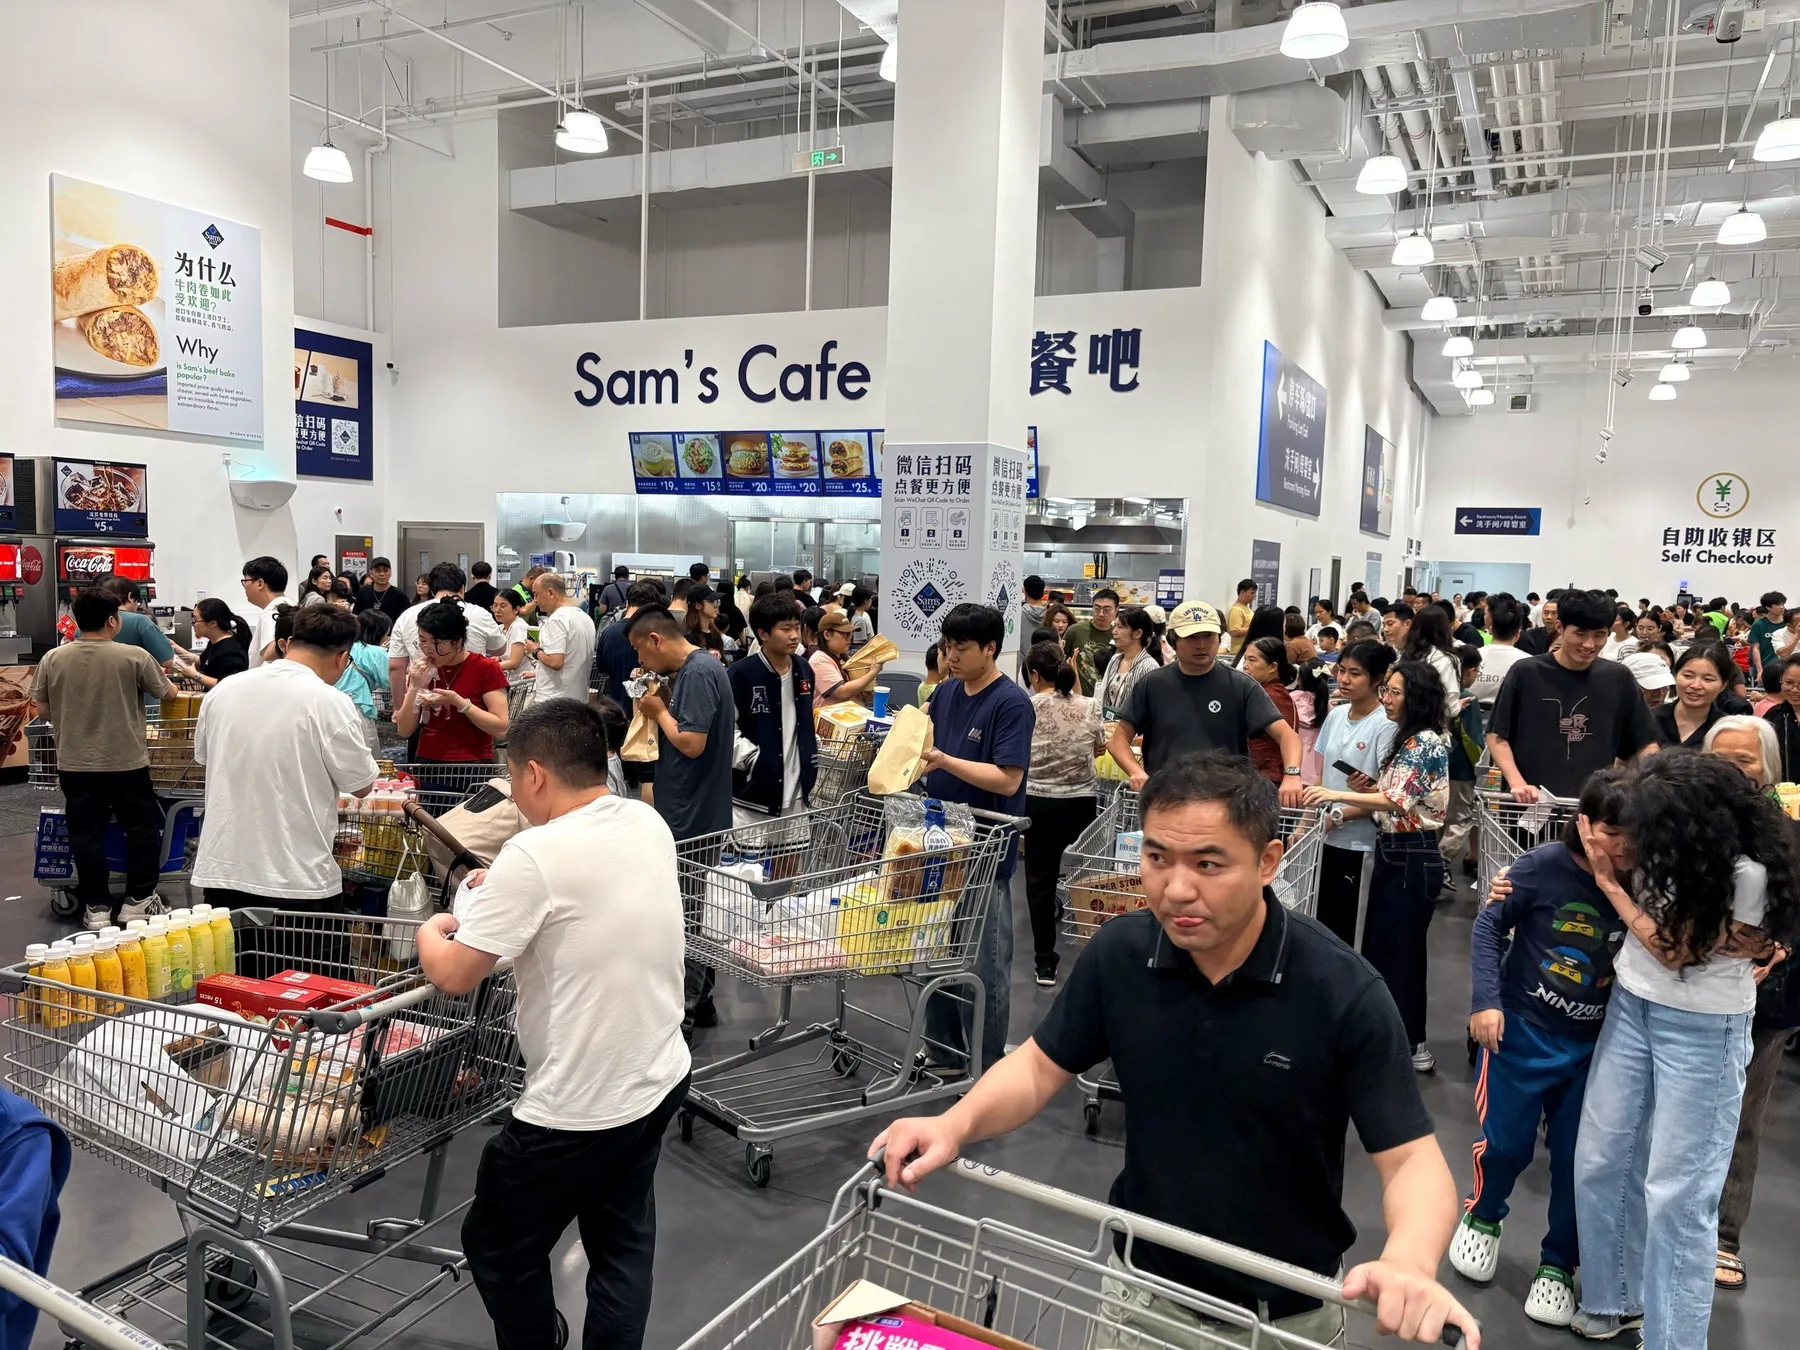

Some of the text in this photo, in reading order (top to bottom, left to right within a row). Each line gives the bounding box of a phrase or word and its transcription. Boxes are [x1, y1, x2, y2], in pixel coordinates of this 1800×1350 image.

[175, 251, 236, 287] 为什么
[175, 279, 231, 302] 牛肉卷如此
[176, 335, 219, 364] Why
[183, 363, 202, 373] Sam's
[204, 366, 219, 376] beef
[220, 368, 236, 378] bake
[1029, 328, 1143, 396] 餐吧
[176, 372, 208, 382] popular?
[574, 340, 871, 408] Sam's Cafe
[896, 455, 972, 476] 微信扫码
[993, 455, 1023, 482] 微信扫码
[894, 478, 971, 495] 点餐更方便
[991, 479, 1022, 500] 点餐更方便
[1663, 527, 1777, 547] 自助收银区
[66, 555, 114, 573] Coca-Cola
[1661, 549, 1773, 564] Self Checkout
[916, 594, 941, 605] Sam's
[214, 996, 223, 1005] 15
